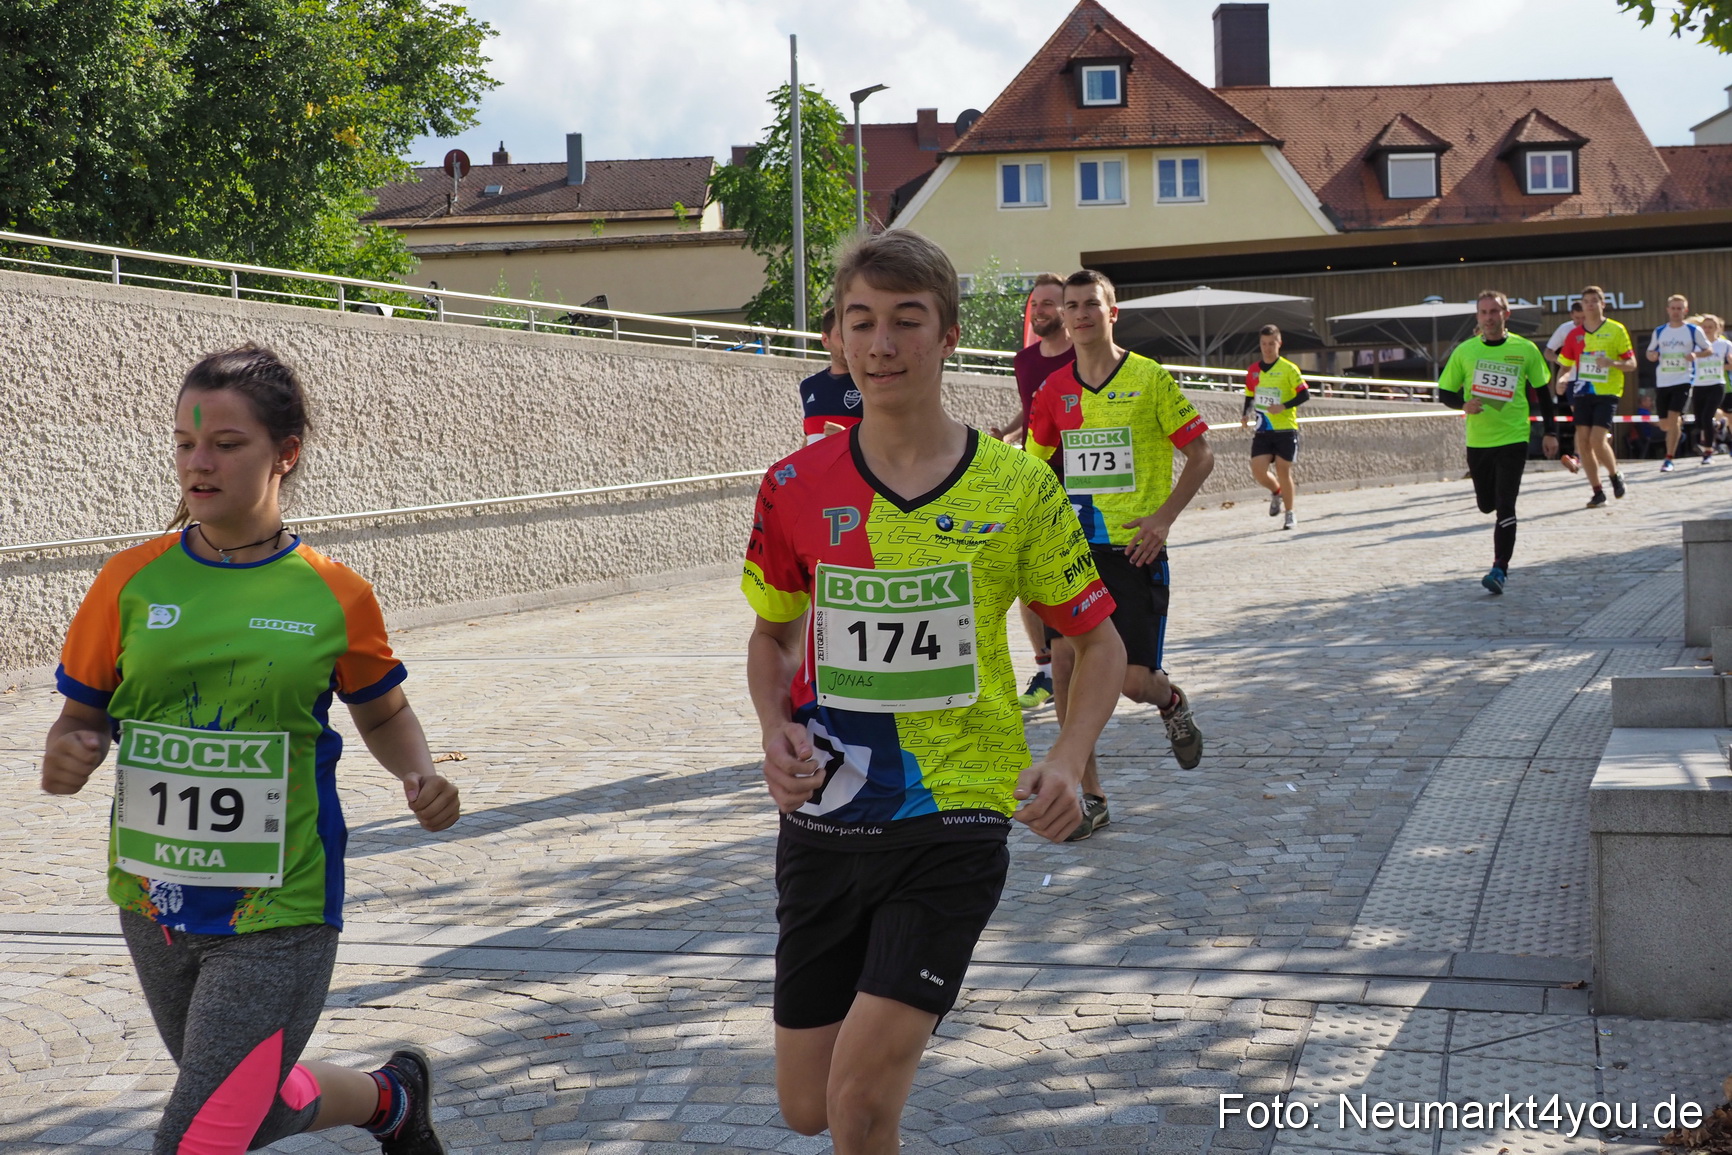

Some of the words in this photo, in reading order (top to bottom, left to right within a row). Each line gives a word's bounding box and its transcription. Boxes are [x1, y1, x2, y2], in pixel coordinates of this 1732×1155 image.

[1482, 373, 1507, 388] 533
[1260, 396, 1274, 405] 179
[1067, 430, 1125, 447] BOCK
[1078, 451, 1116, 471] 173
[826, 571, 959, 607] BOCK
[249, 618, 316, 636] BOCK
[958, 618, 970, 626] E6
[847, 620, 941, 664] 174
[828, 671, 874, 690] JONAS
[129, 729, 271, 772] BOCK
[267, 792, 280, 801] E6
[149, 781, 244, 832] 119
[154, 843, 226, 867] KYRA
[929, 974, 944, 987] JAKO
